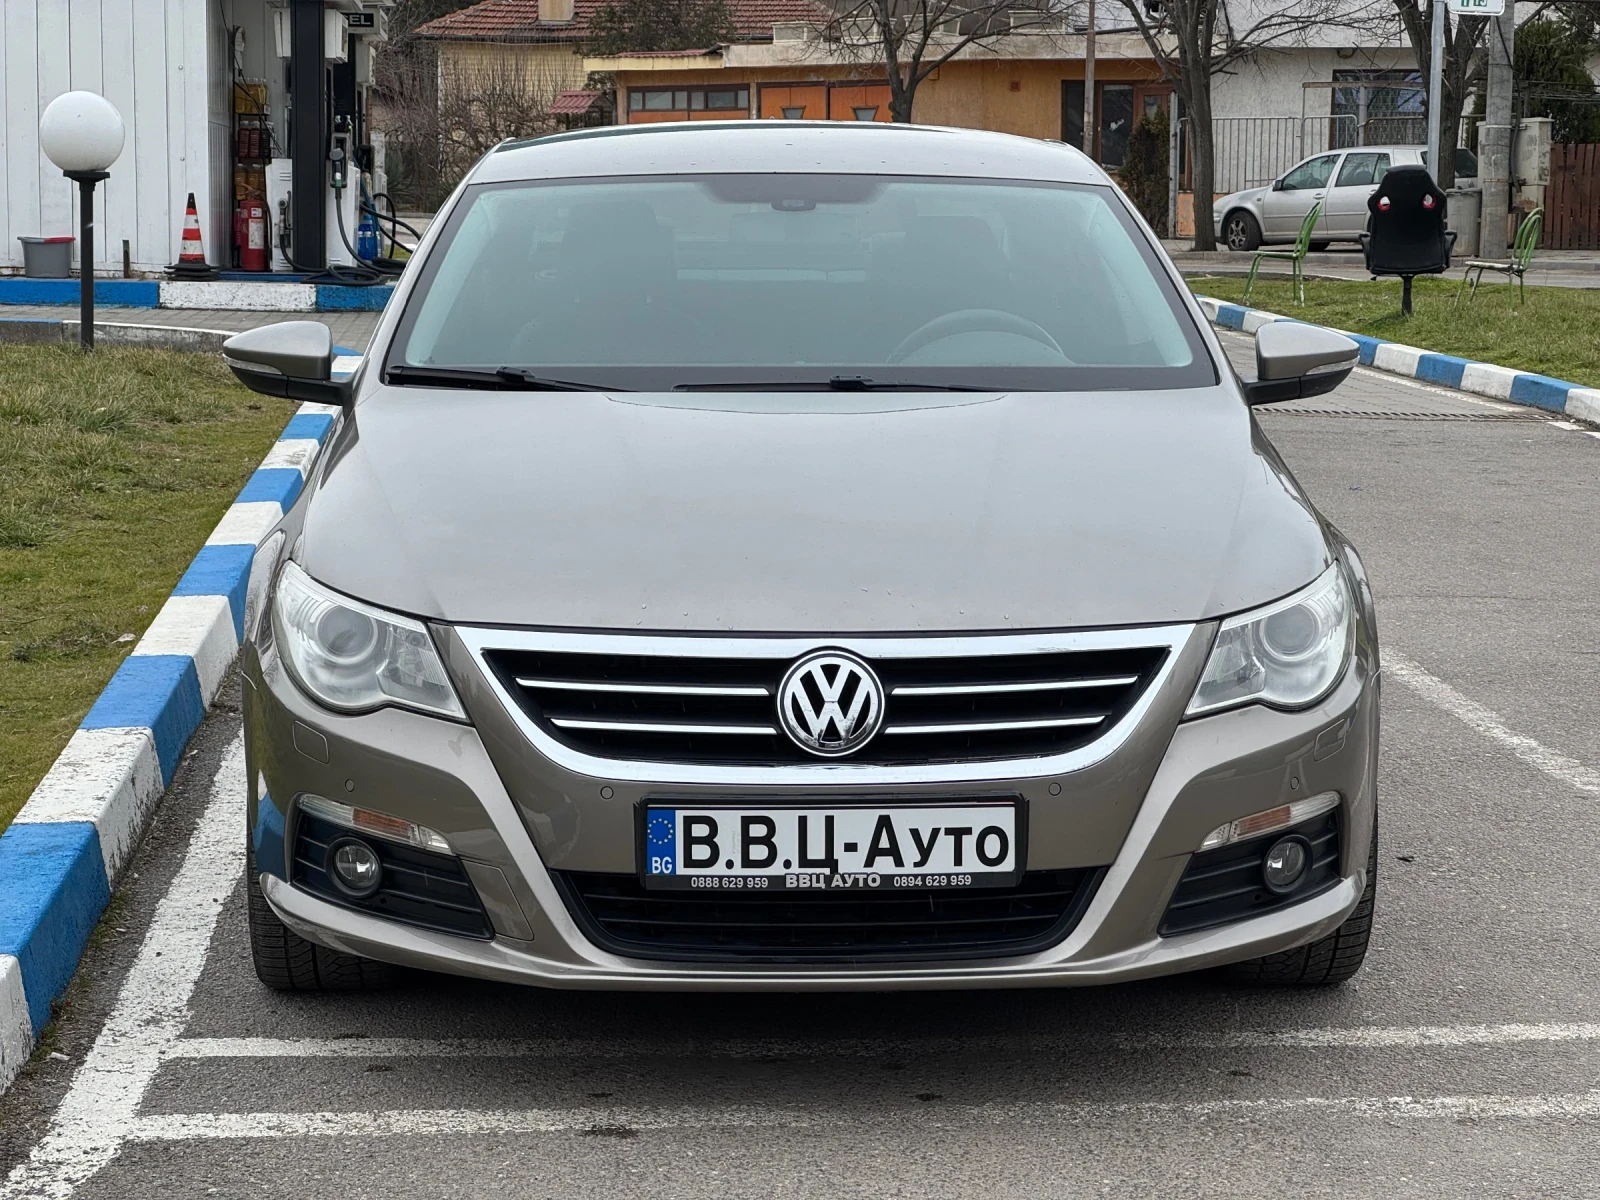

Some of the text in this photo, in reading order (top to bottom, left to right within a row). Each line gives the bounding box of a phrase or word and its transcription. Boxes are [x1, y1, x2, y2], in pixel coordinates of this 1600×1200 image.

[343, 14, 371, 25] EL
[651, 856, 673, 874] BG
[691, 877, 769, 888] 0888 629 959
[785, 873, 881, 889] ВВЦ АУТО
[893, 875, 972, 887] 0894 629 959
